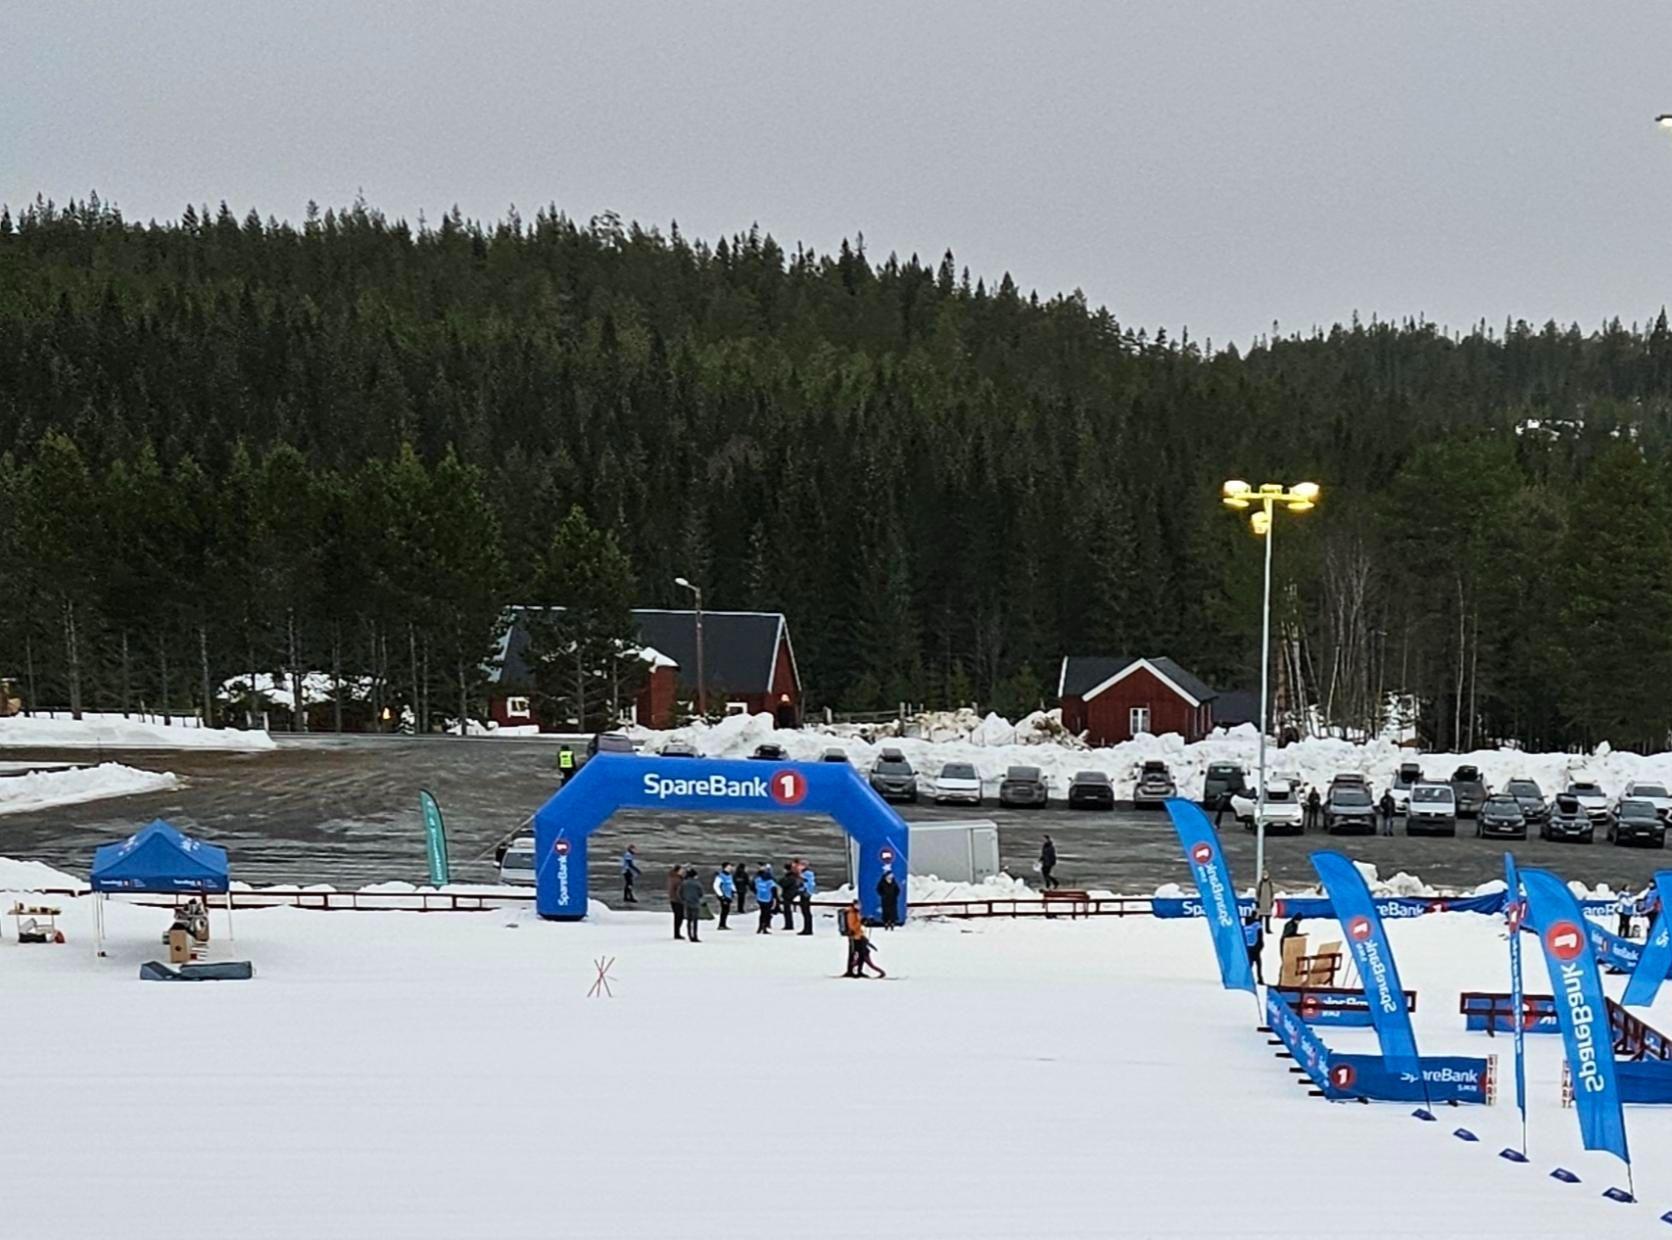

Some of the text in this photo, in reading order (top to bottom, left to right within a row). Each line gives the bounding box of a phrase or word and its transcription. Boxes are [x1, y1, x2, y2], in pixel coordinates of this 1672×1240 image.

[643, 773, 793, 799] SpareBank 1
[558, 856, 568, 906] SpareBank
[1337, 1069, 1348, 1085] 1
